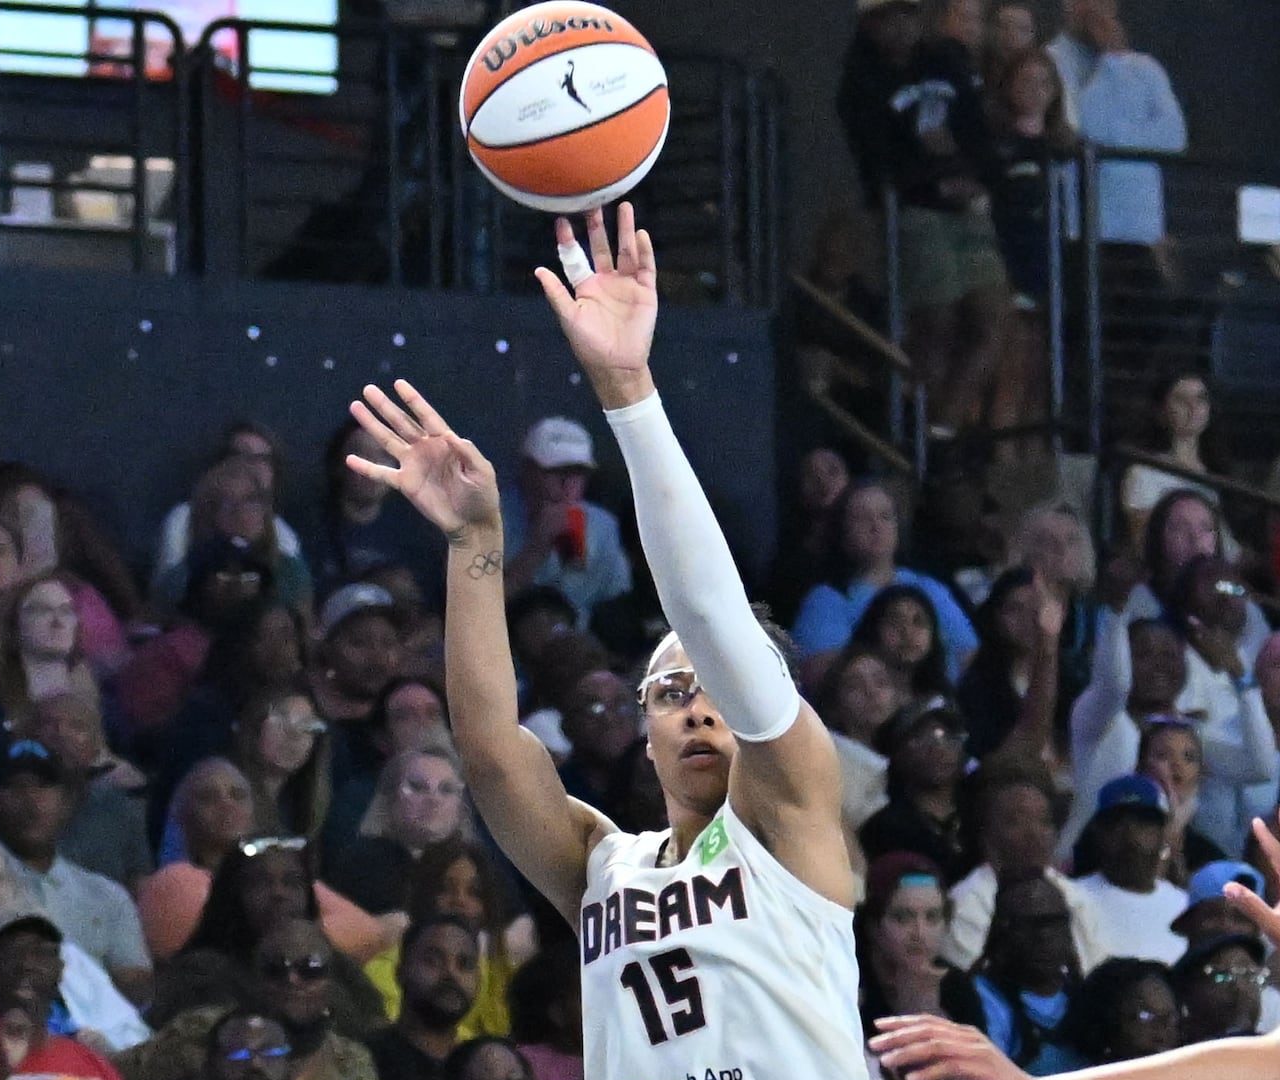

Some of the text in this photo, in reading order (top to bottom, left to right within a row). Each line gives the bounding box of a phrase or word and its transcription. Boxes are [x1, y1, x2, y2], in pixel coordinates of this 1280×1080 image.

[483, 14, 614, 72] Wilson
[581, 866, 750, 966] DREAM
[619, 947, 707, 1046] 15
